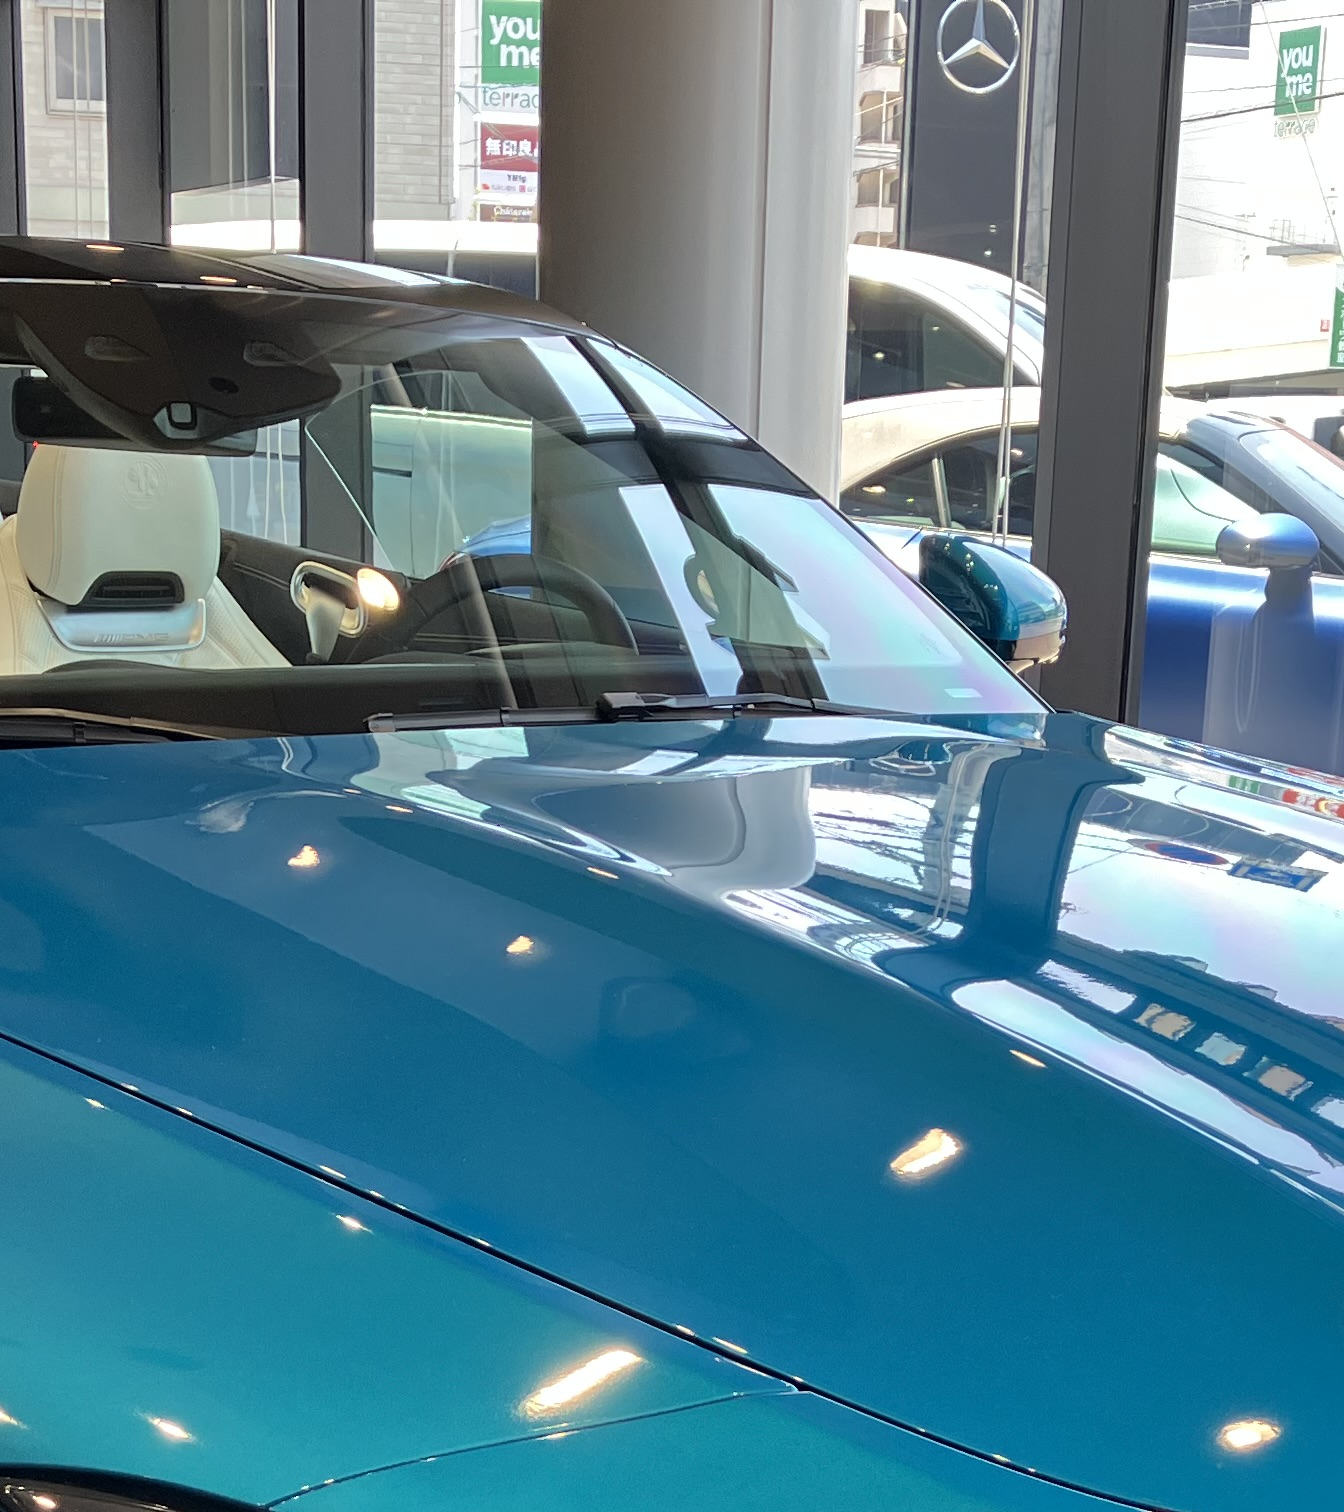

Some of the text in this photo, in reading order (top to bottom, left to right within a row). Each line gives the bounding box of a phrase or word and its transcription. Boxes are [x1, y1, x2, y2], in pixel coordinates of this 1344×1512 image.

[488, 14, 540, 45] you
[499, 43, 540, 69] me
[1281, 44, 1314, 78] you
[1285, 72, 1313, 98] me
